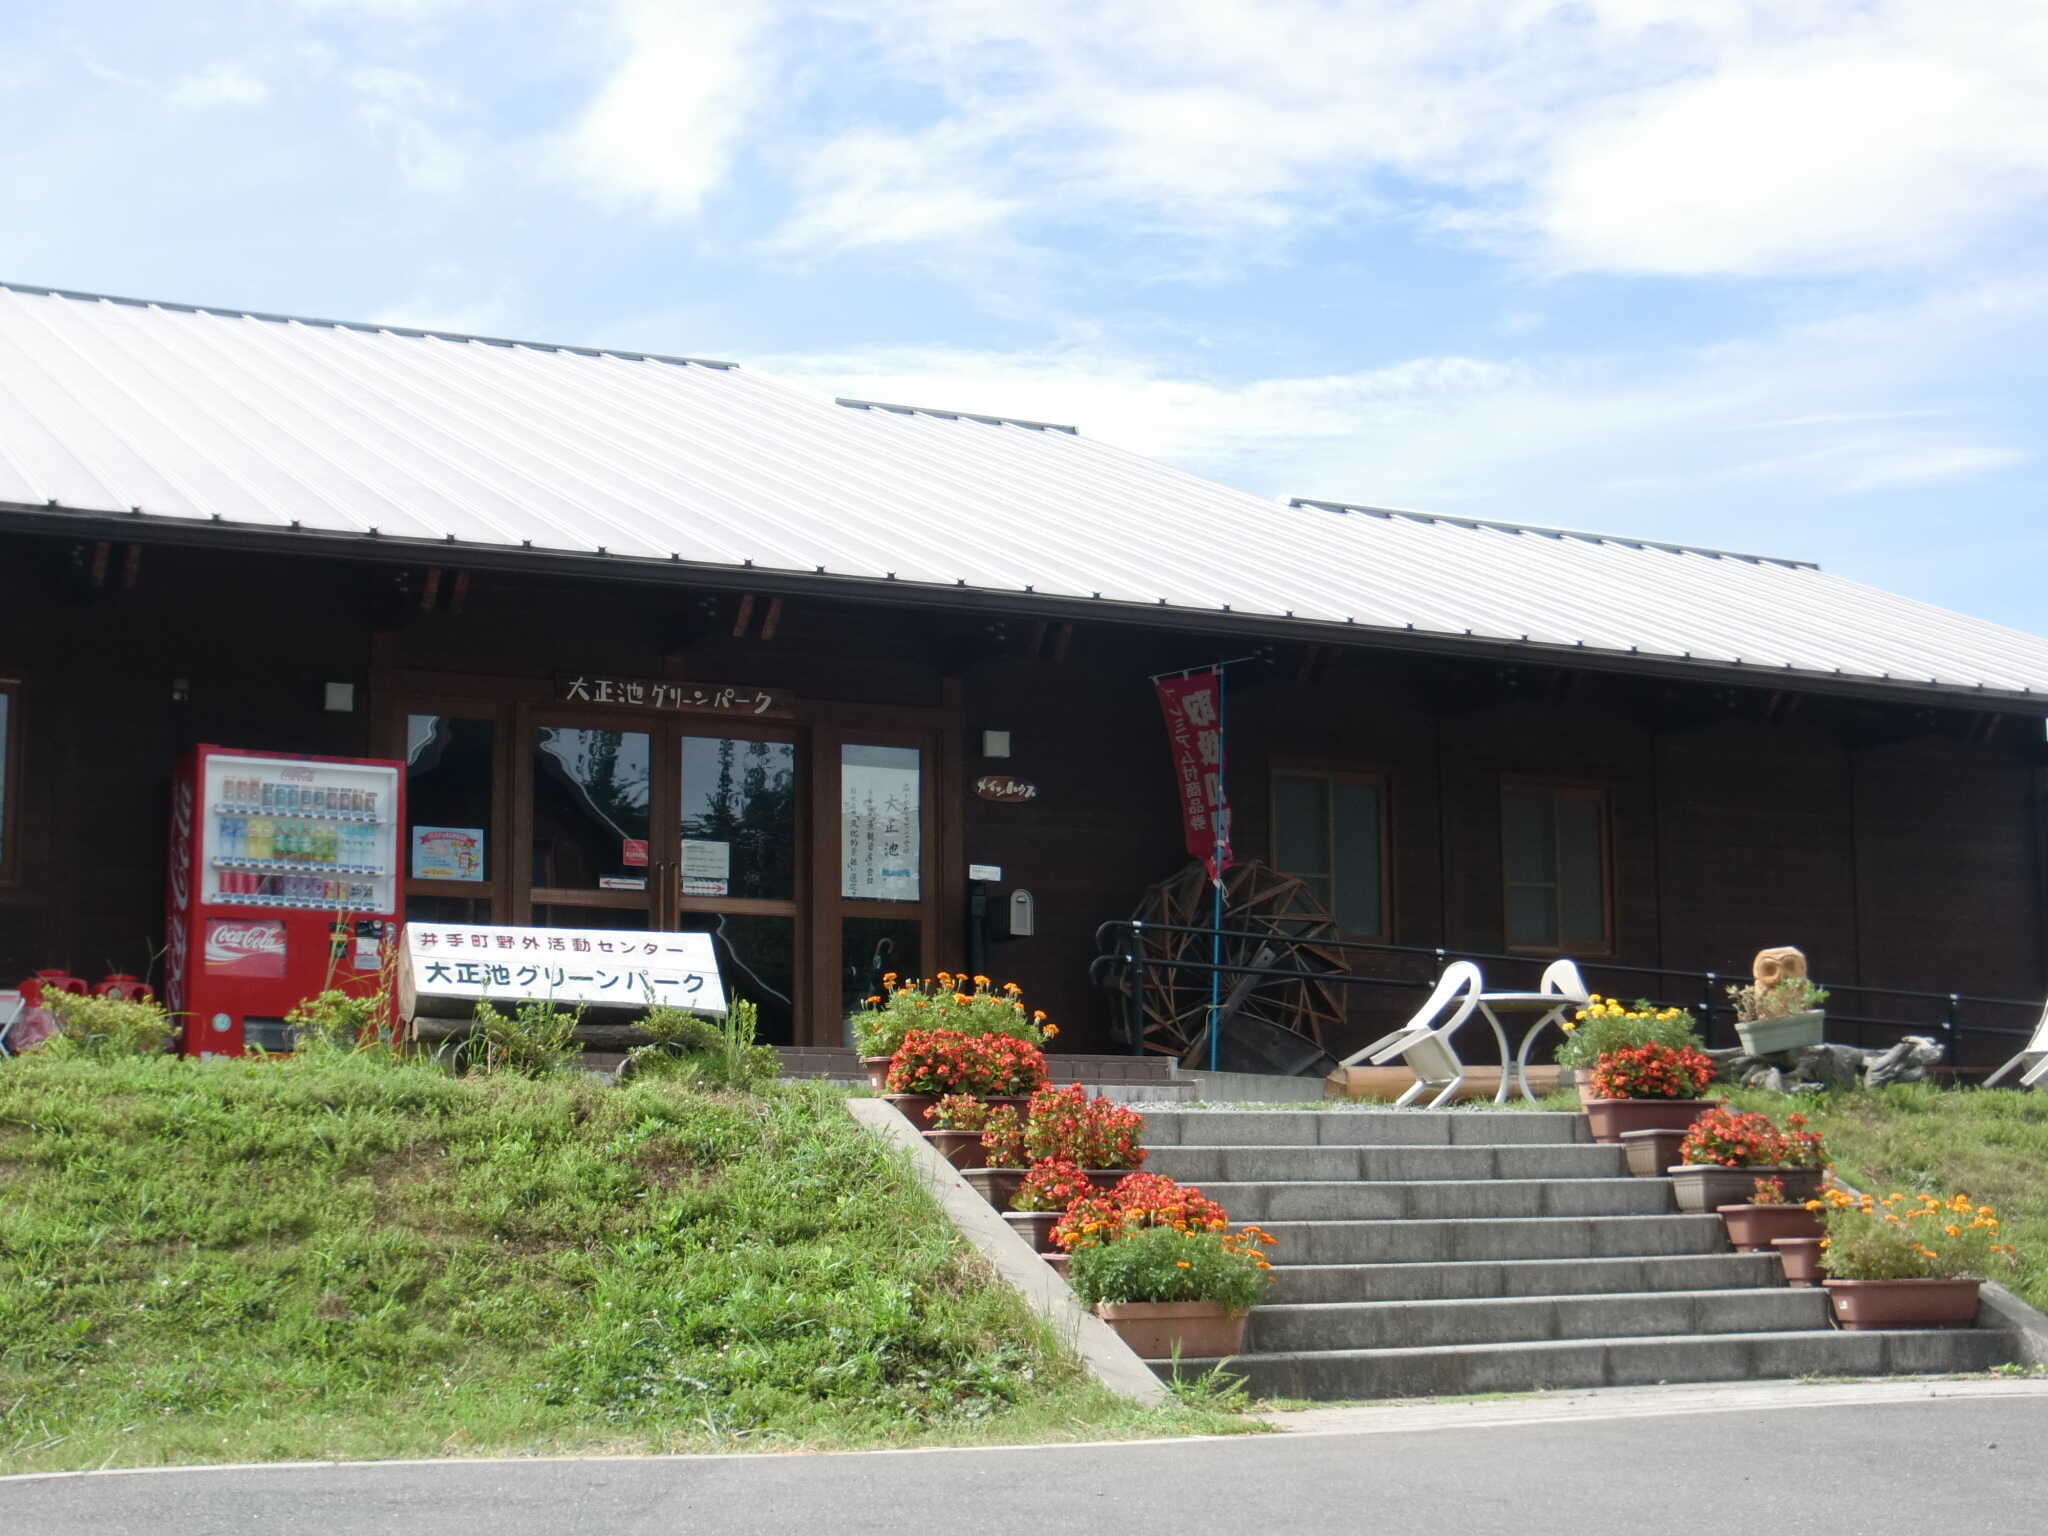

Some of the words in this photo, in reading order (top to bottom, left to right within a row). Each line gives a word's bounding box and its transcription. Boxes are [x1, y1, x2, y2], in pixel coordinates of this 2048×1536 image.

[566, 676, 773, 714] 大正池グリーンパーク
[419, 931, 685, 957] 井手町野外活動センター
[424, 960, 705, 994] 大正池グリーンパーク
